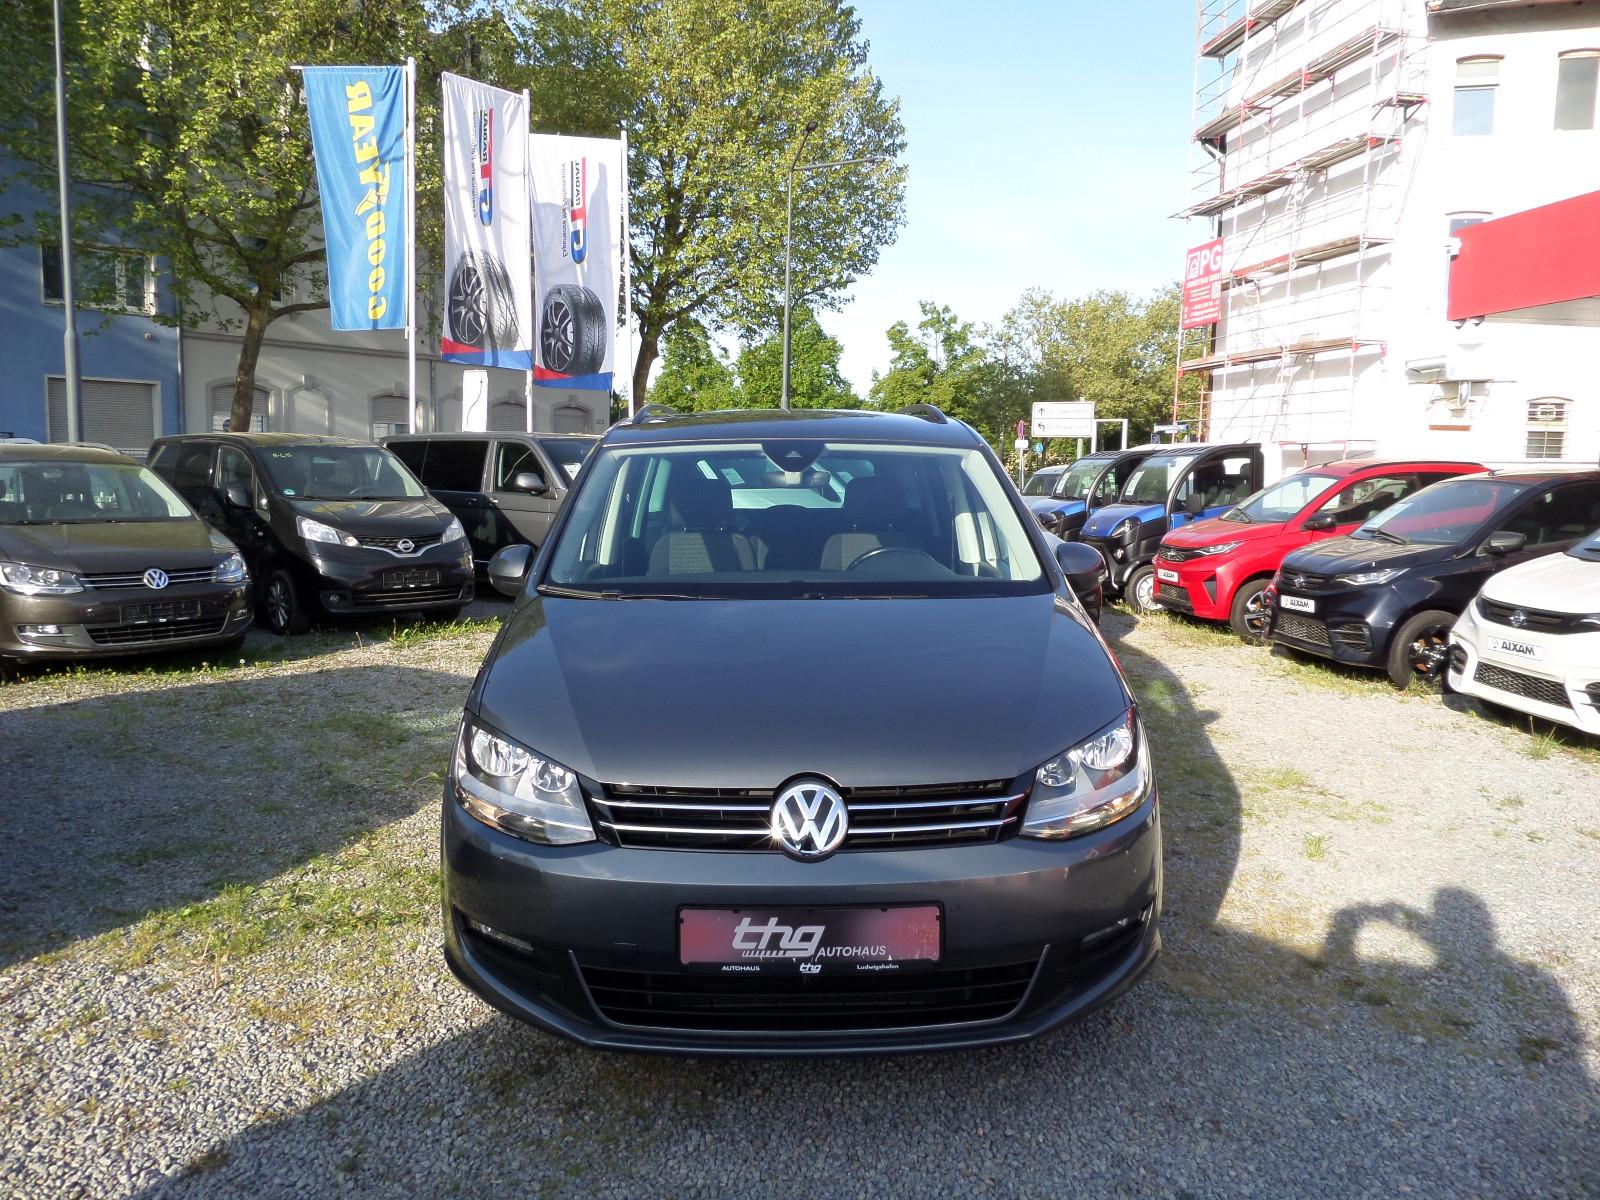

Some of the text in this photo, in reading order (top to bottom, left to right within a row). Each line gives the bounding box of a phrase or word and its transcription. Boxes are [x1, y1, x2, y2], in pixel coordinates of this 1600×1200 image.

[1289, 599, 1310, 609] AIXAM
[1501, 642, 1535, 656] AIXAM
[731, 917, 826, 958] thg
[816, 945, 887, 958] AUTOHAUS
[856, 963, 900, 971] Ludwigshafen
